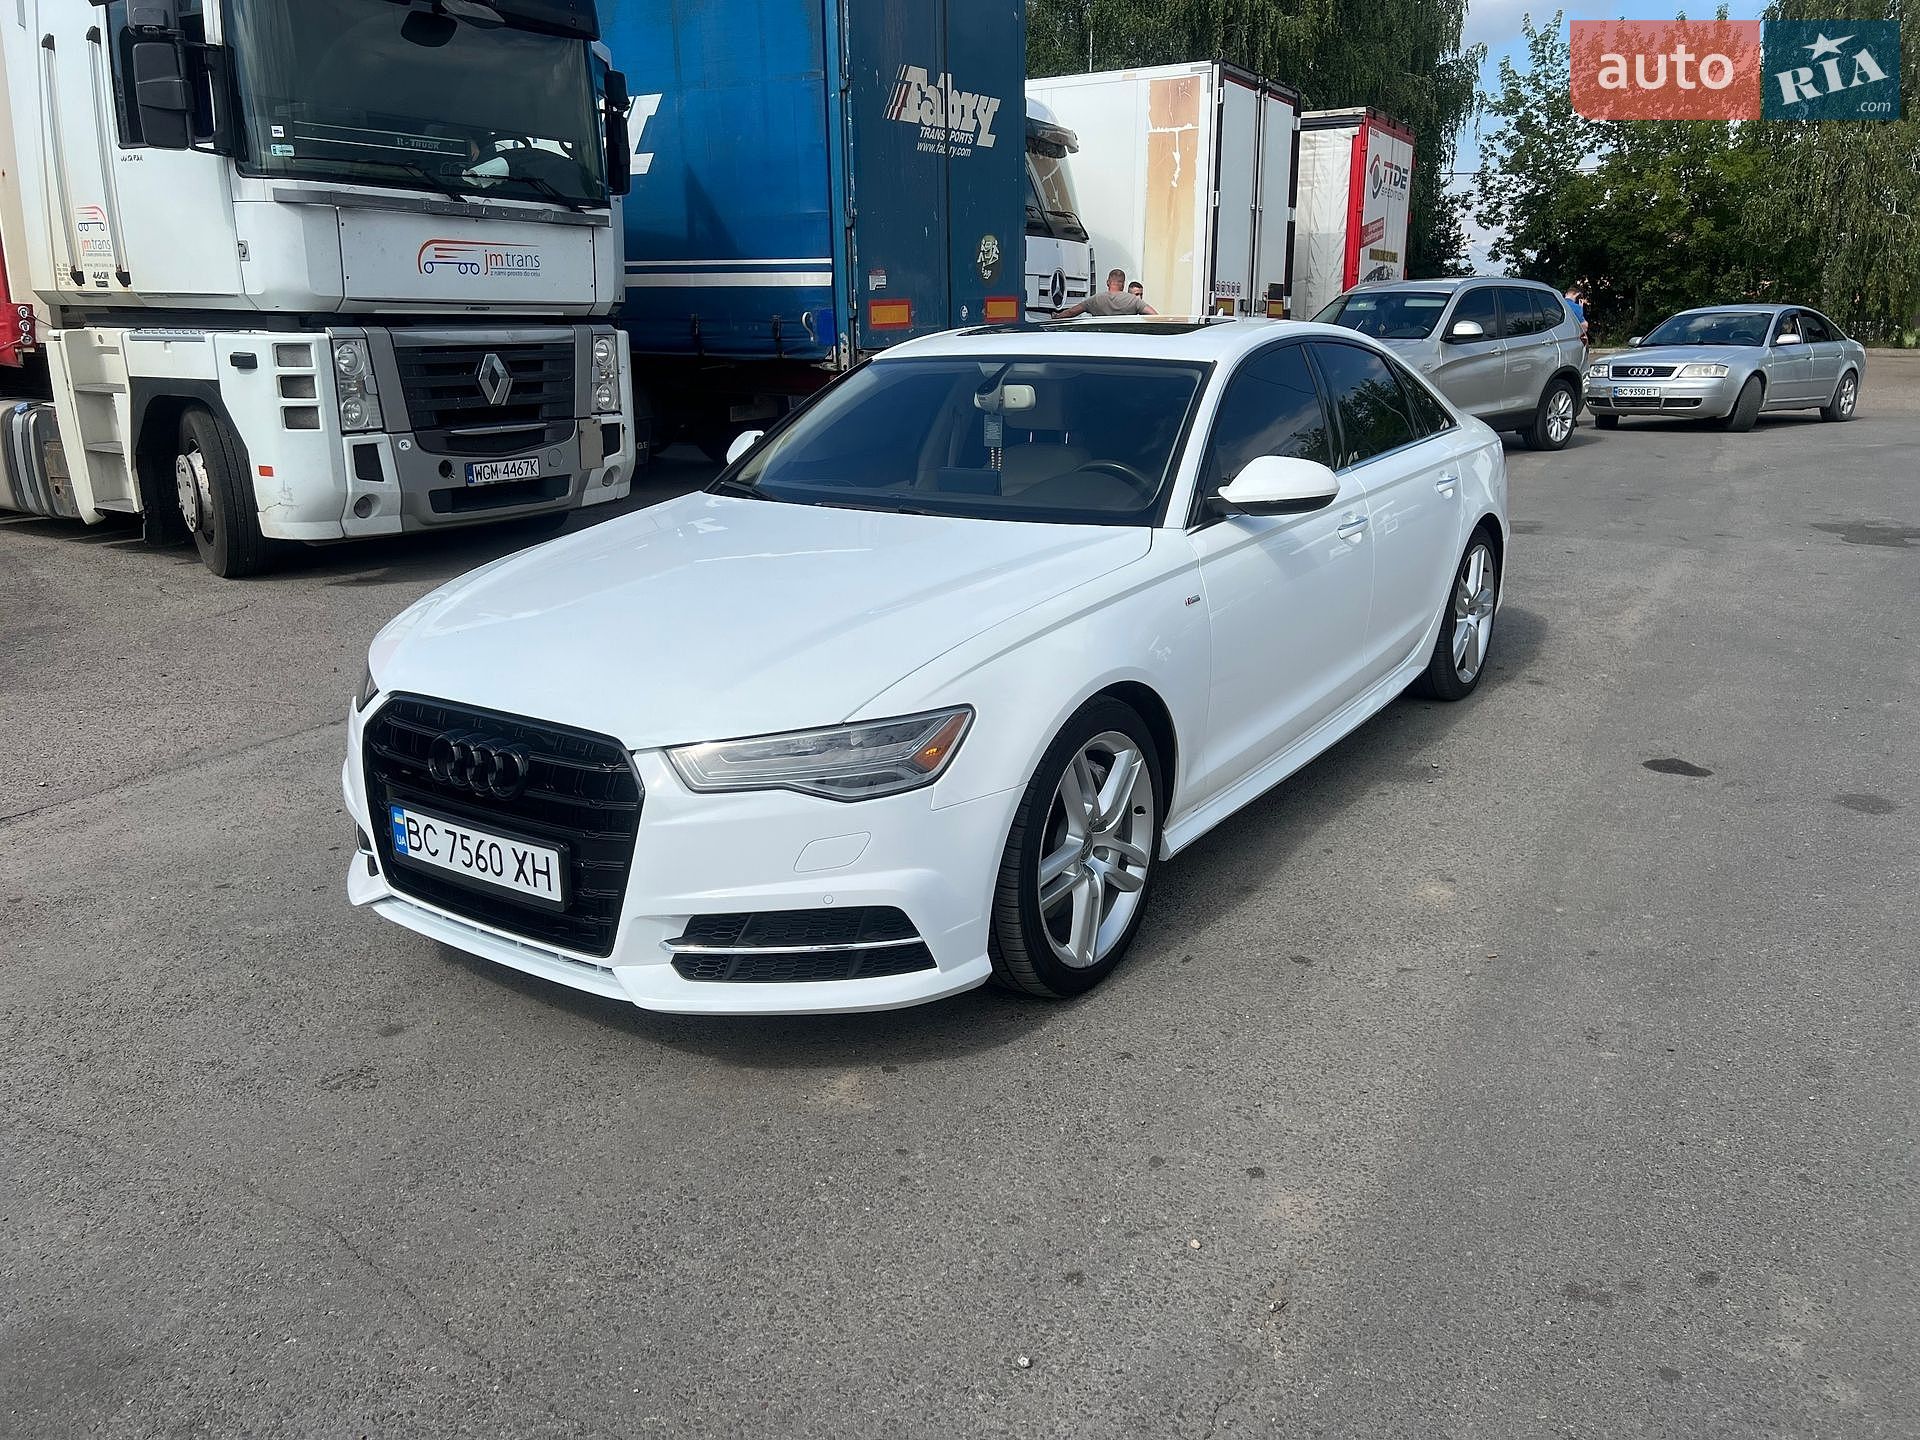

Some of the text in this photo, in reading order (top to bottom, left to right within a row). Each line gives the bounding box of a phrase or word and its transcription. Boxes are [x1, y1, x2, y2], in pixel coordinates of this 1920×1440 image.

[898, 65, 1001, 148] Fabry
[1618, 388, 1628, 396] BC
[474, 459, 538, 481] WGM 4467K
[397, 835, 407, 847] UA
[406, 817, 552, 892] BC 7560 XH
